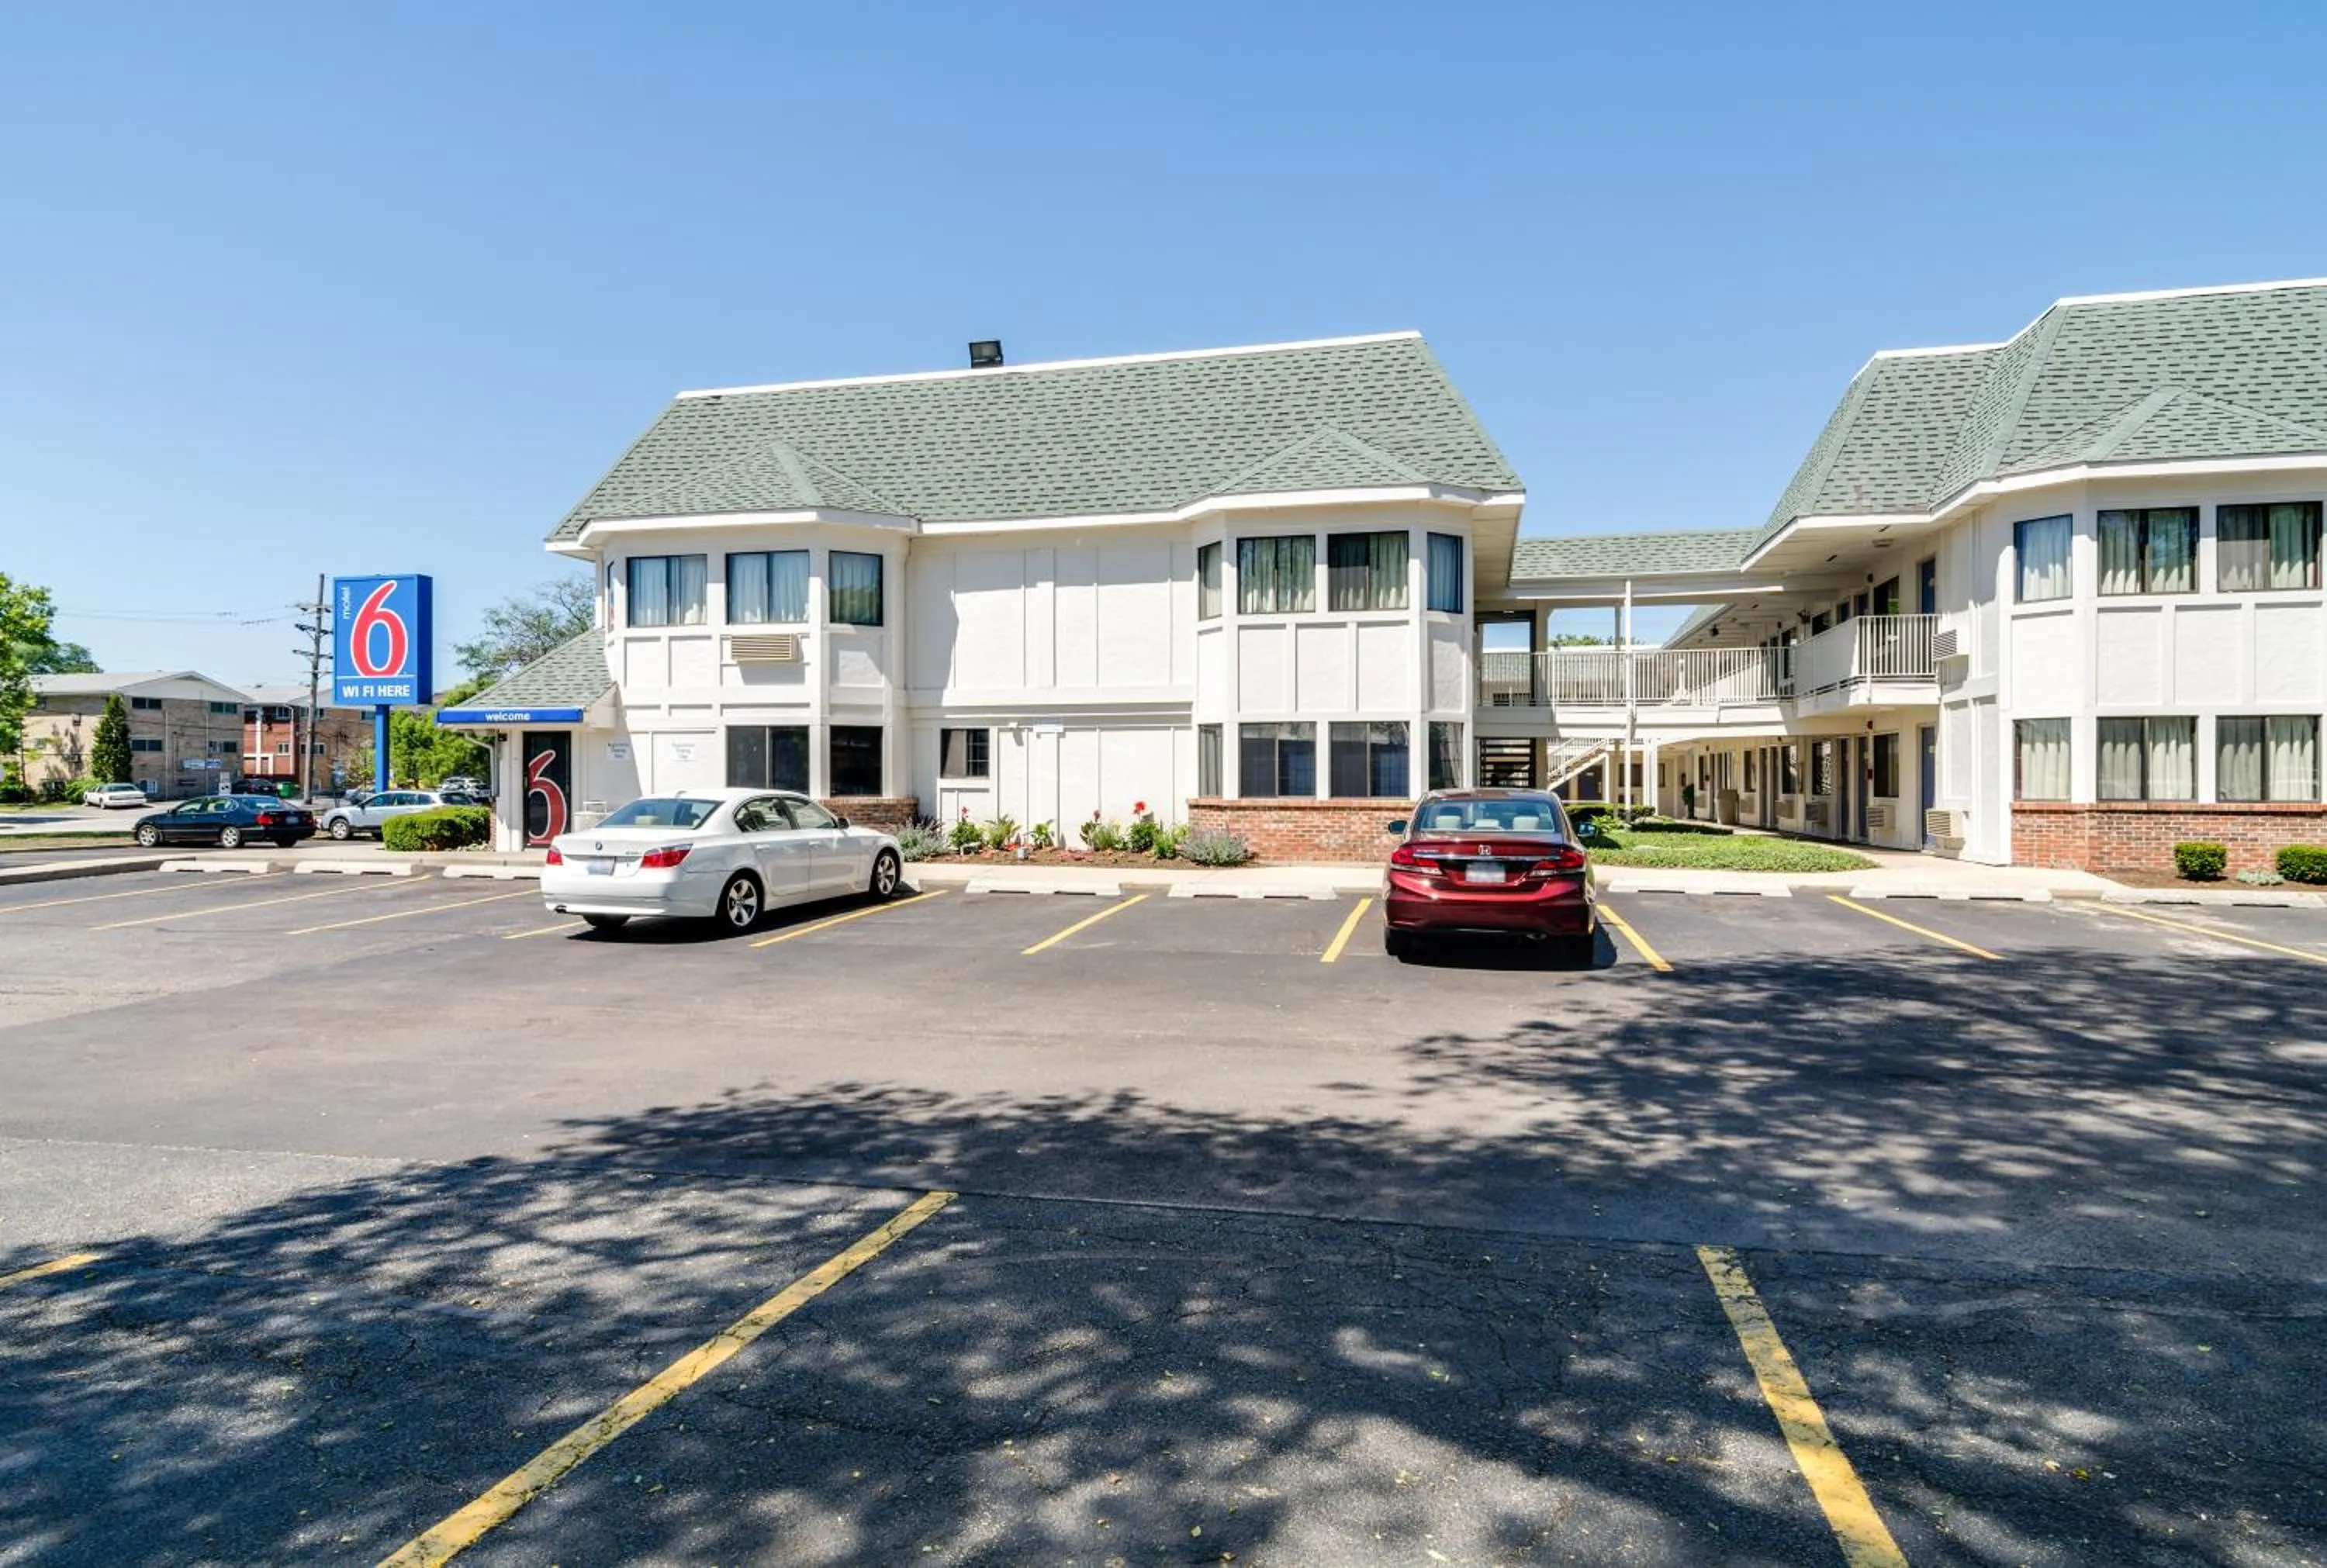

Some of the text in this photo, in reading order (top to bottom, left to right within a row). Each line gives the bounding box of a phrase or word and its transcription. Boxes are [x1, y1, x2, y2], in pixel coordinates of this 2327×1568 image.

[341, 580, 409, 678] motel 6
[342, 685, 410, 697] WI FI HERE
[485, 711, 531, 721] welcome
